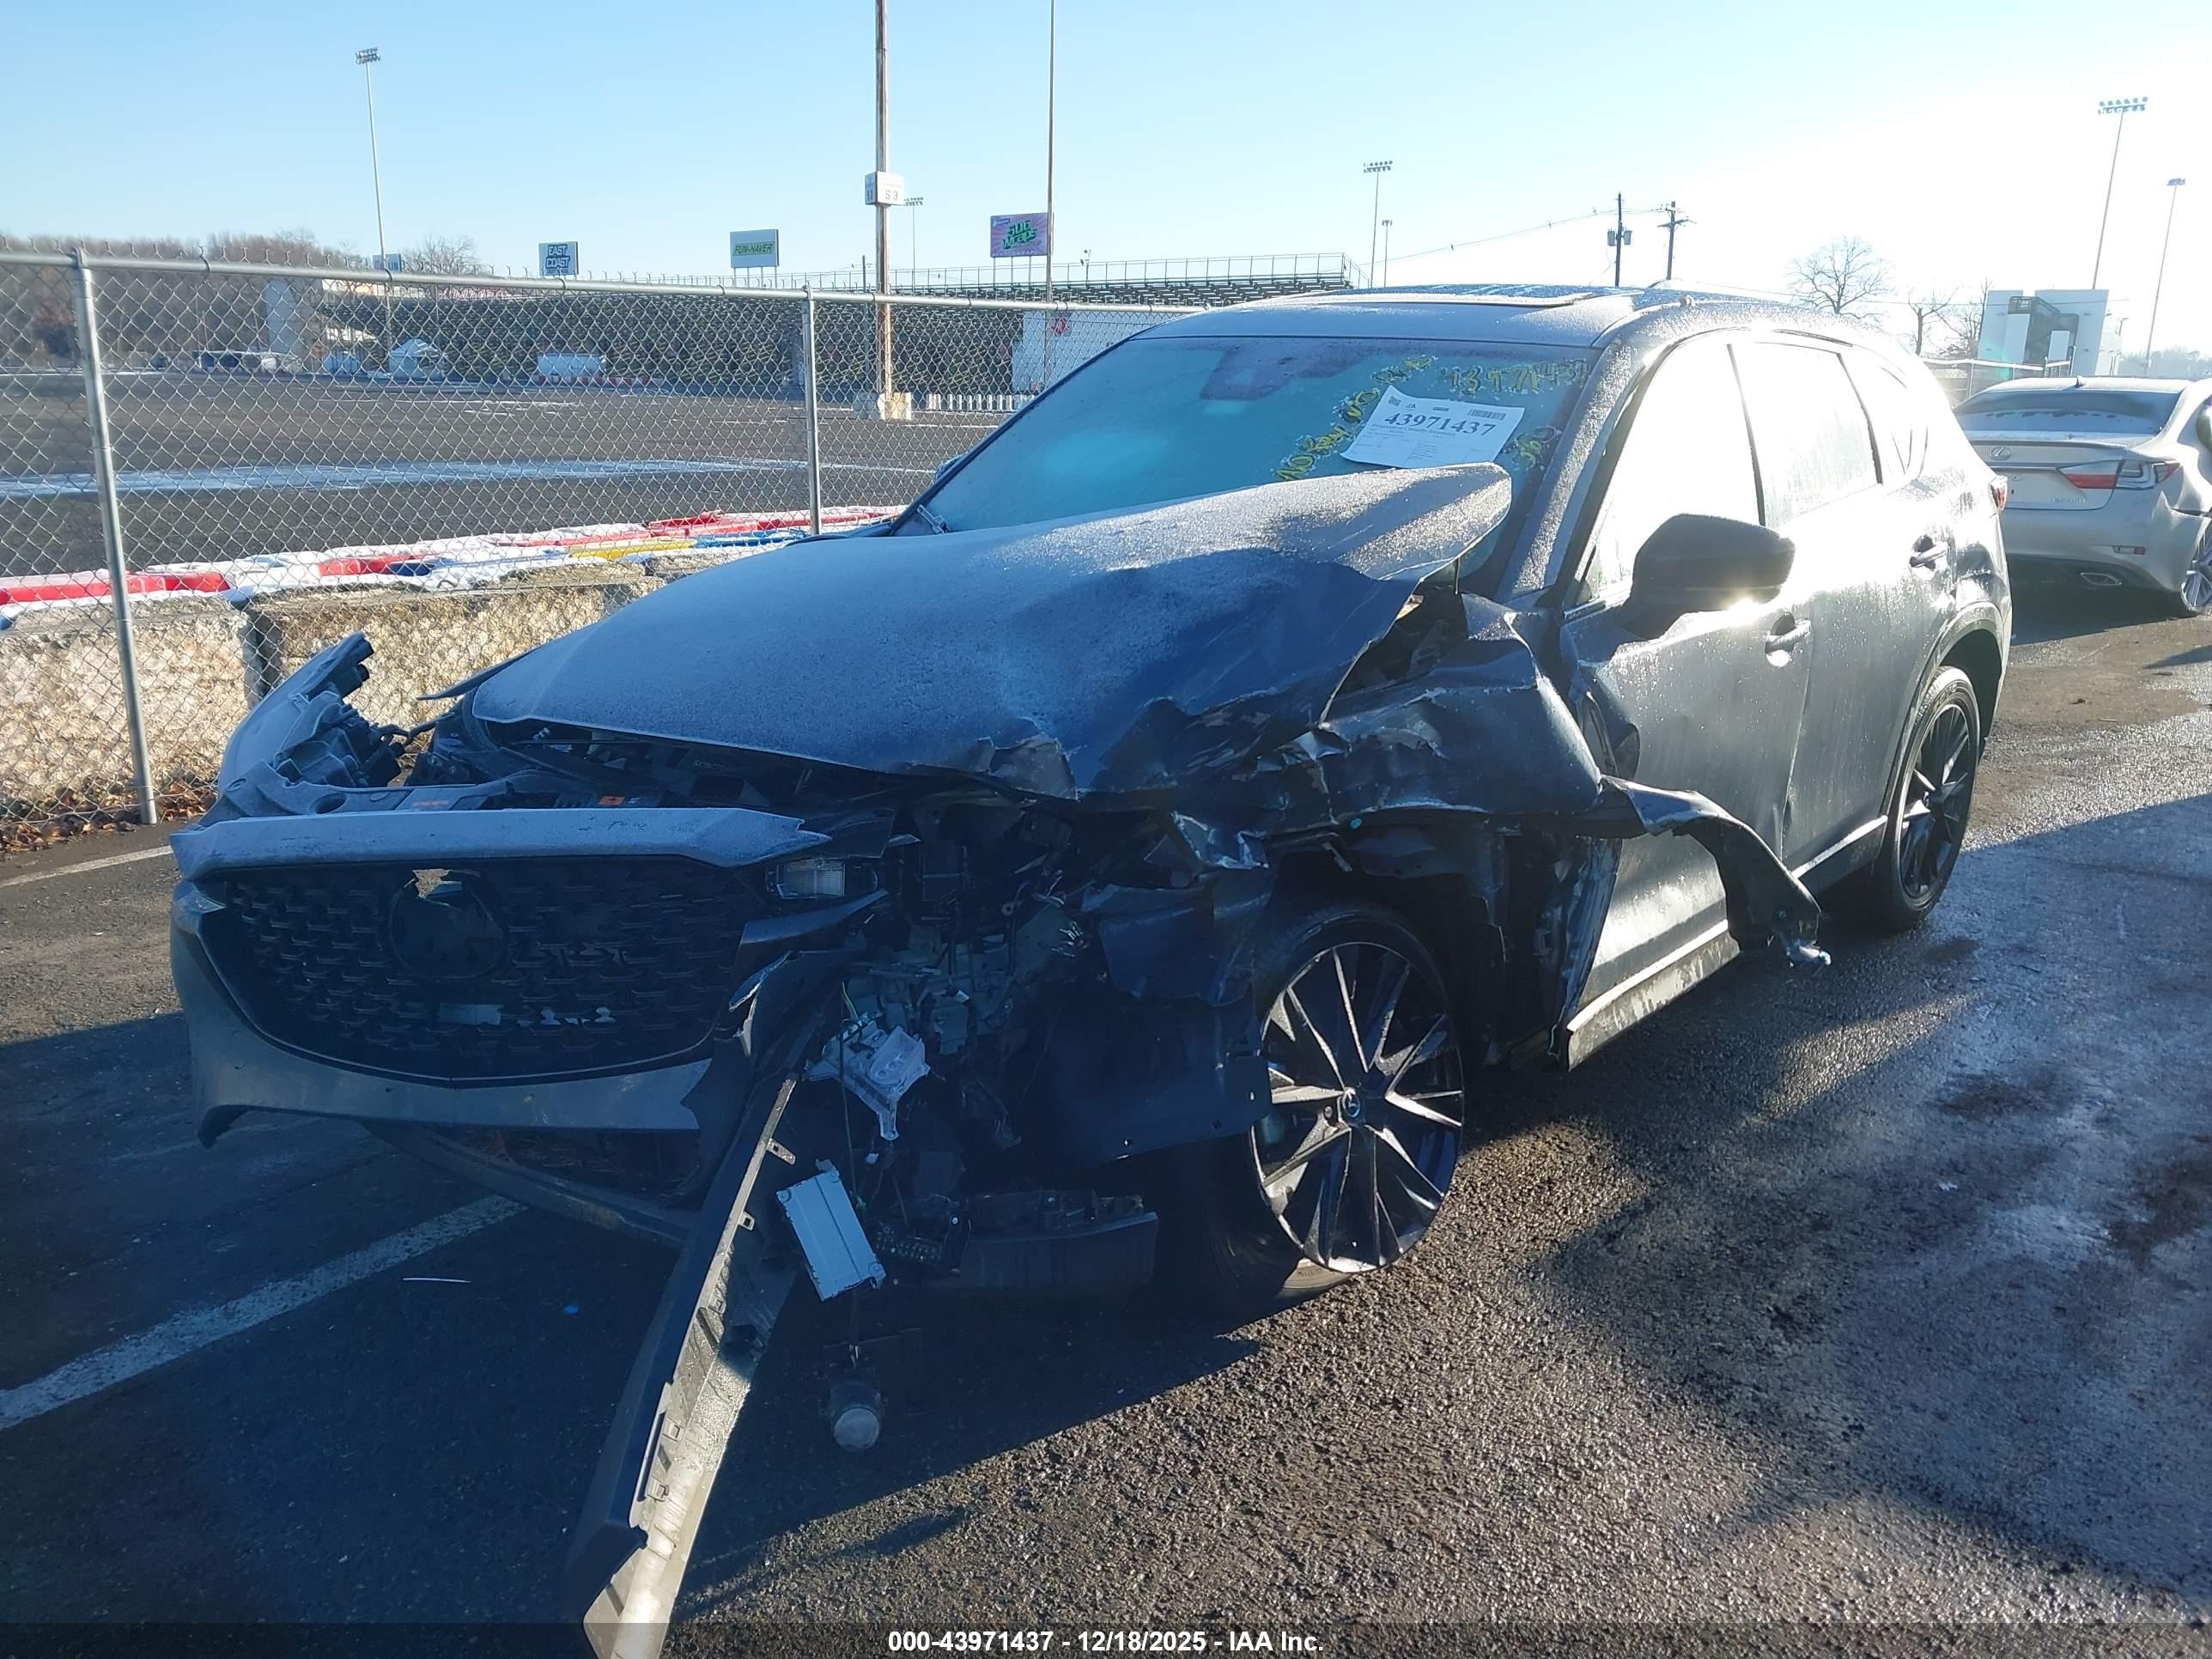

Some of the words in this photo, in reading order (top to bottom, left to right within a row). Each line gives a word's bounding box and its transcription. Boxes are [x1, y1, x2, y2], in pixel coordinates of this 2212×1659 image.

[548, 244, 568, 257] EAST
[545, 255, 570, 269] COAST
[1384, 412, 1497, 436] 43971437
